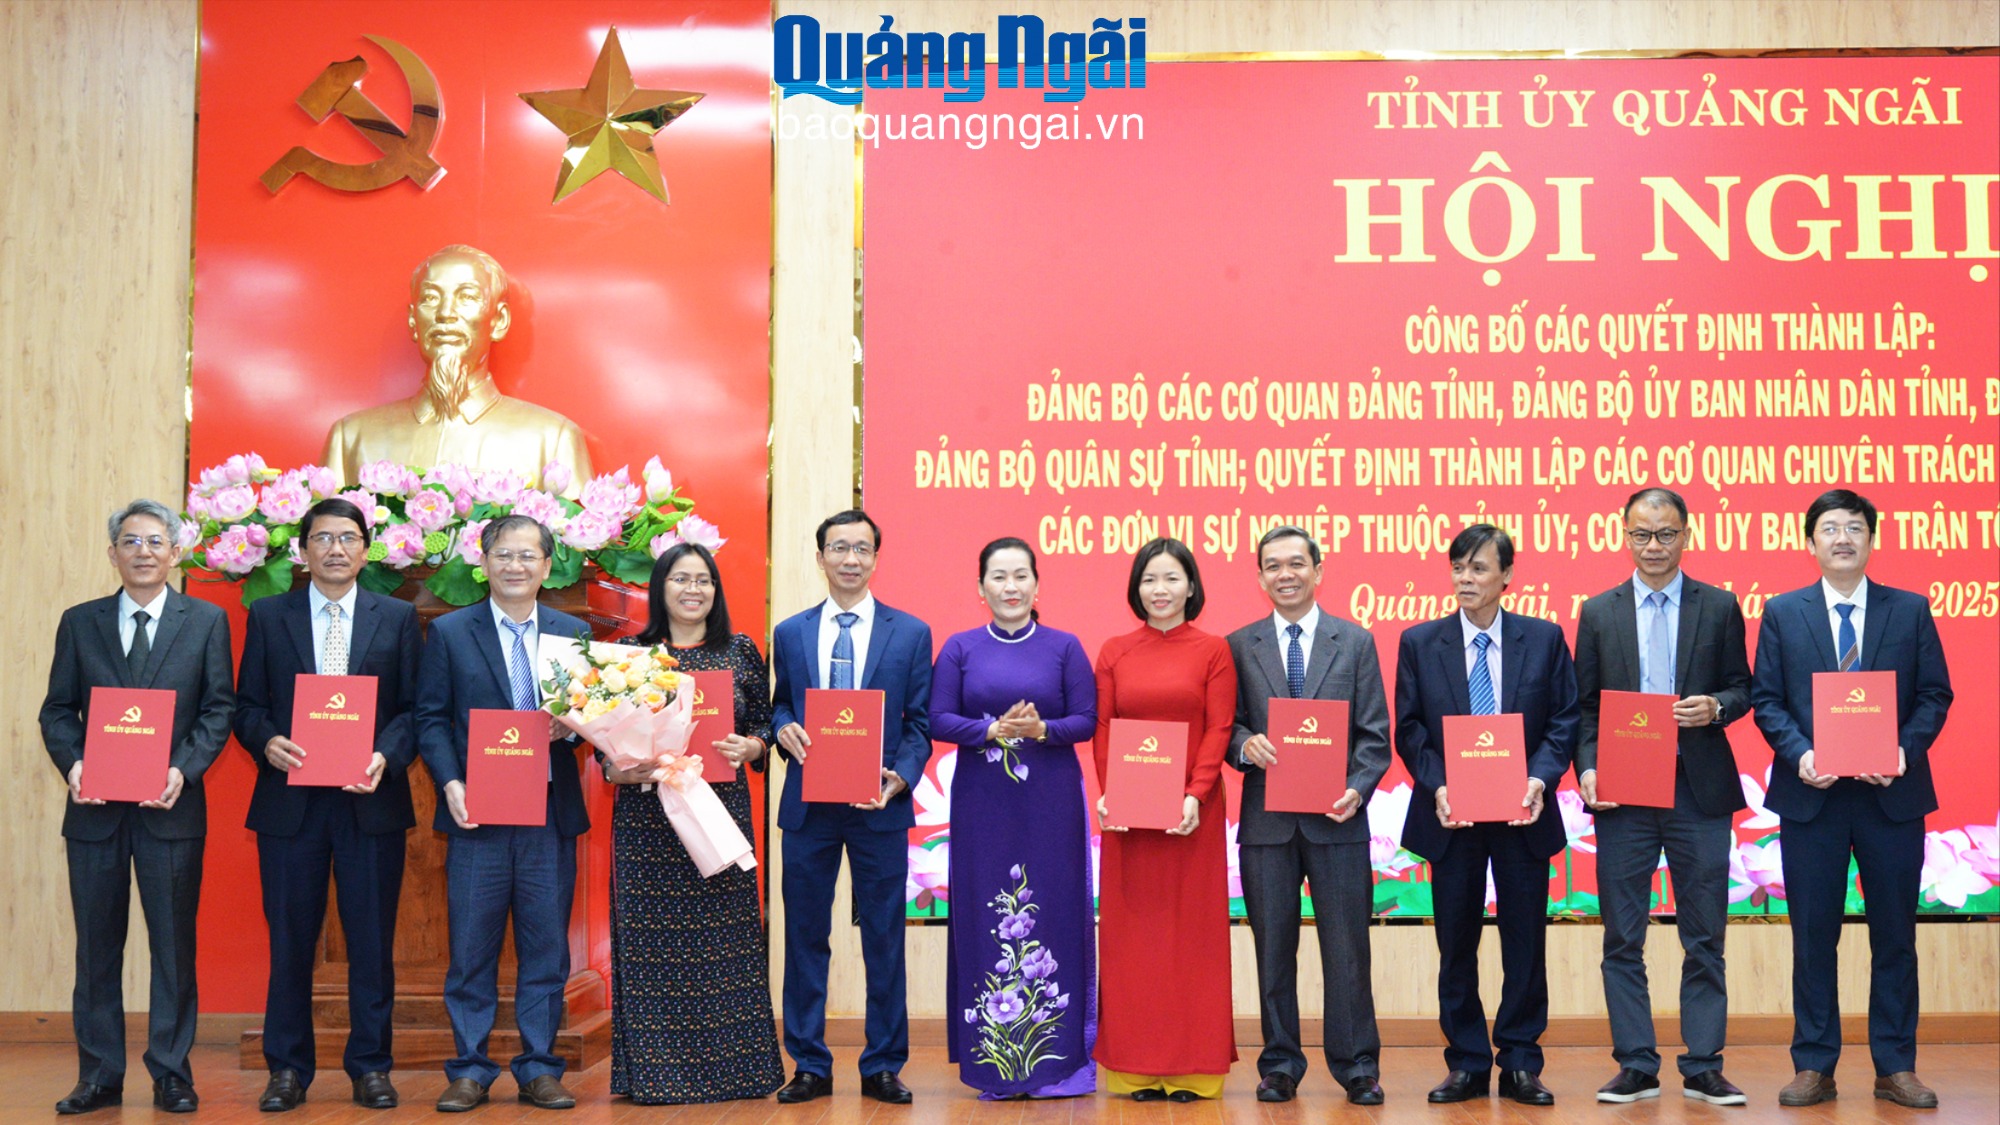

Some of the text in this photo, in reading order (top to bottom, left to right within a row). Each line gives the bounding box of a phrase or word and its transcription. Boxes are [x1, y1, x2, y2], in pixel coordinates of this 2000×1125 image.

[1367, 72, 1963, 136] TỈNH ỦY QUẢNG NGÃI
[1332, 150, 2000, 287] HỘI NGHỊ
[1404, 298, 1935, 360] CÔNG BỐ CÁC QUYẾT ĐỊNH THÀNH LẬP:
[1027, 367, 1102, 422] ĐẢNG
[1111, 372, 1149, 428] BỘ
[1157, 372, 1212, 422] CÁC
[1221, 376, 1259, 421] CƠ
[1265, 381, 1340, 427] QUAN
[1348, 366, 1423, 421] ĐẢNG
[1431, 367, 1504, 427] TỈNH,
[1512, 365, 1588, 420] ĐẢNG
[1596, 369, 1634, 425] BỘ
[1644, 364, 1681, 419] ỦY
[1690, 379, 1746, 418] BAN
[1755, 368, 1829, 417] NHÂN
[1839, 368, 1896, 417] DÂN
[1903, 364, 1977, 424] TỈNH,
[914, 432, 1995, 496] ĐẢNG BỘ QUÂN SỰ TỈNH; QUYẾT ĐỊNH THÀNH LẬP CÁC CƠ QUAN CHUYÊN TRÁCH
[1038, 505, 1094, 555] CÁC
[1102, 509, 1159, 555] ĐƠN
[1202, 508, 1242, 562] SỰ
[1357, 503, 1451, 560] THUỘC
[1533, 498, 1579, 559] ỦY;
[1587, 507, 1625, 553] CƠ
[1715, 497, 1752, 552] ỦY
[1893, 501, 1969, 557] TRẬN
[1976, 502, 2000, 549] T
[1350, 581, 1458, 630] Quảng
[1504, 582, 1558, 624] gãi,
[1929, 581, 2000, 618] 2025
